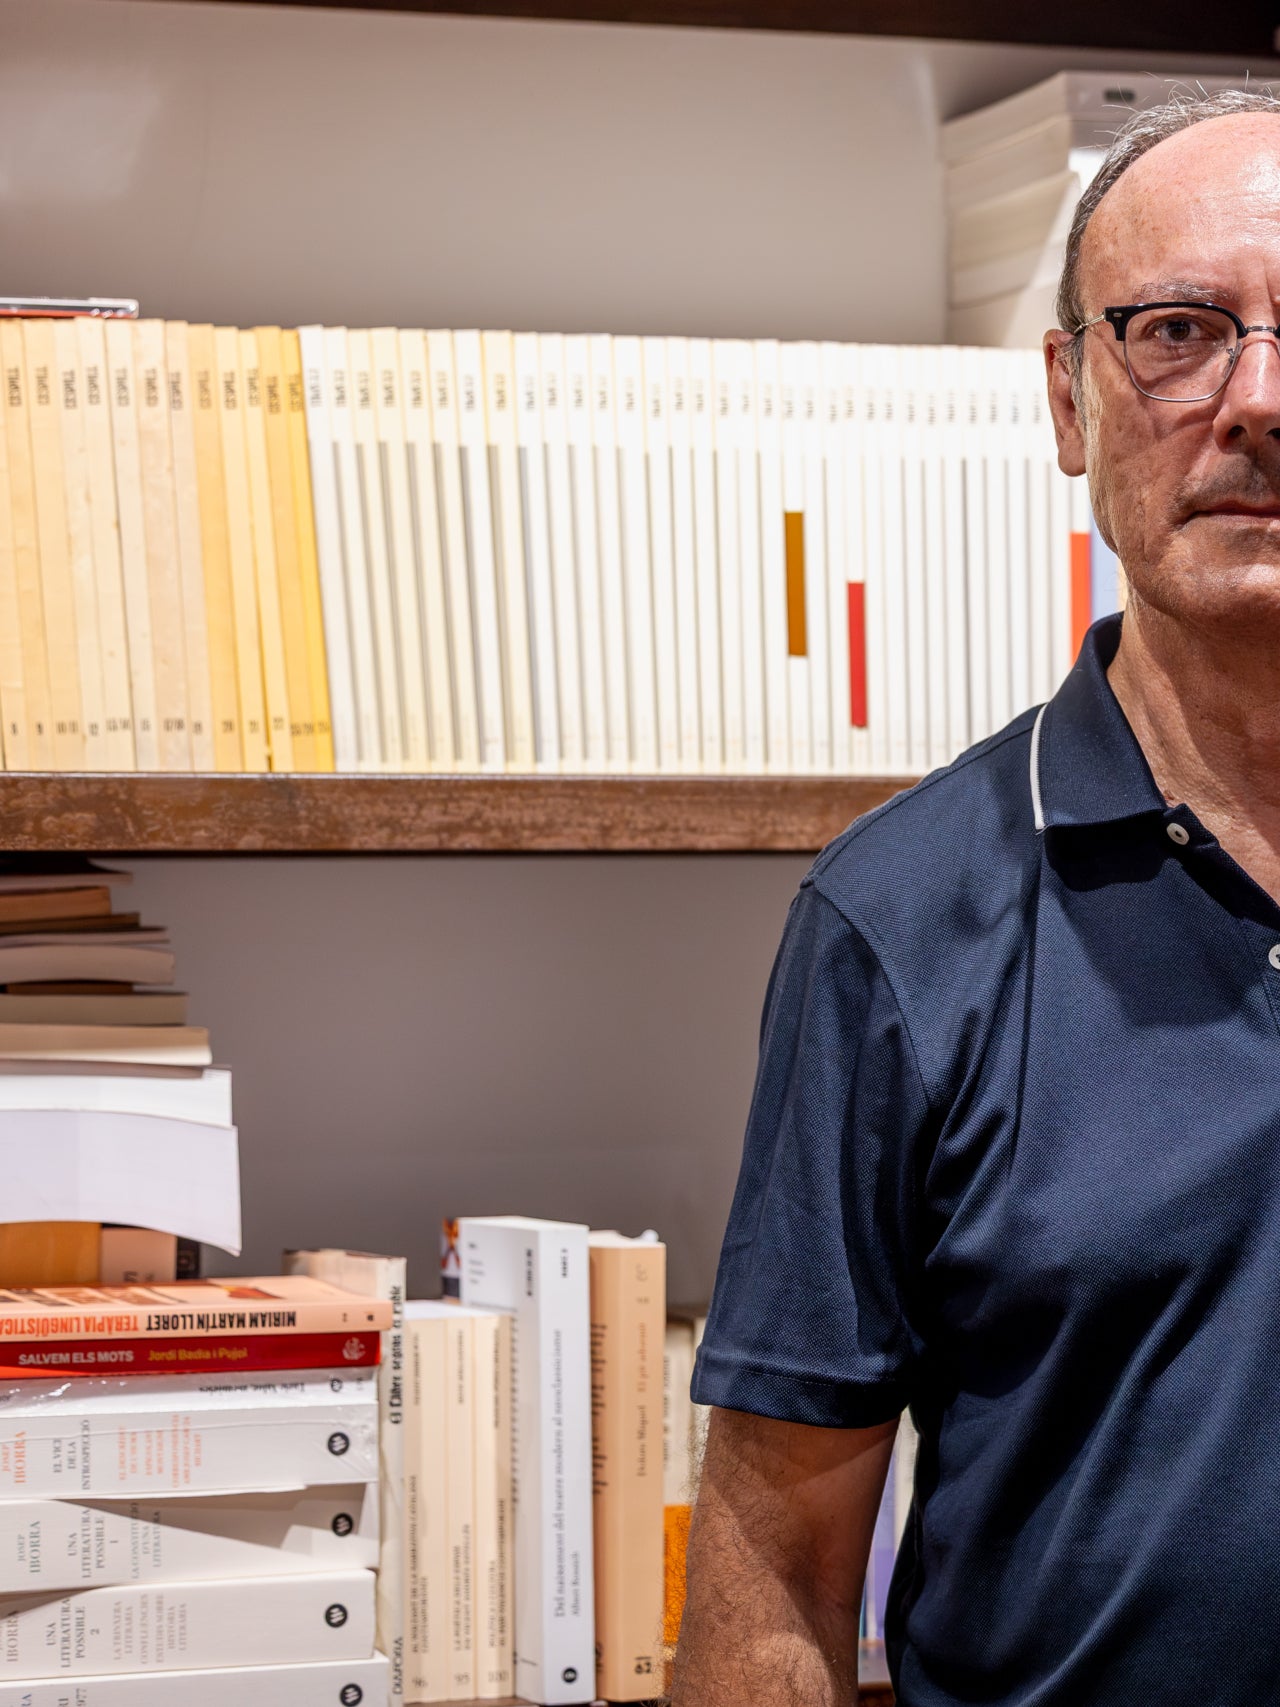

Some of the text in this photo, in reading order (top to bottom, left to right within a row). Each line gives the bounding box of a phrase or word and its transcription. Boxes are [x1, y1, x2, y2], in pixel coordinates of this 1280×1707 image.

[0, 1314, 139, 1337] TERÀPIA LINGÜÍSTICA
[145, 1311, 297, 1332] MIRIAM MARTÍN LLORET
[18, 1350, 134, 1365] SALVEM ELS MOTS
[148, 1349, 177, 1361] Jordi
[218, 1347, 248, 1361] Pujol
[2, 1444, 11, 1472] JOSEP
[14, 1430, 26, 1484] IBORRA
[53, 1461, 62, 1474] EL
[68, 1441, 76, 1470] DE LA
[81, 1419, 91, 1490] INTROSPECCIÓ
[551, 1329, 566, 1618] Del naixement del teatre modern al neoclassicisme
[17, 1534, 26, 1562] JOSEP
[29, 1520, 41, 1573] IBORRA
[68, 1532, 78, 1556] UNA
[81, 1509, 92, 1578] LITERATURA
[95, 1516, 105, 1569] POSSIBLE
[152, 1511, 161, 1568] LITERATURA
[6, 1610, 18, 1662] IBORRA
[46, 1622, 56, 1646] UNA
[60, 1598, 71, 1668] LITERATURA
[75, 1606, 85, 1659] POSSIBLE
[113, 1601, 122, 1660] LA TRINXERA
[156, 1594, 164, 1663] ESTUDIS SOBRE
